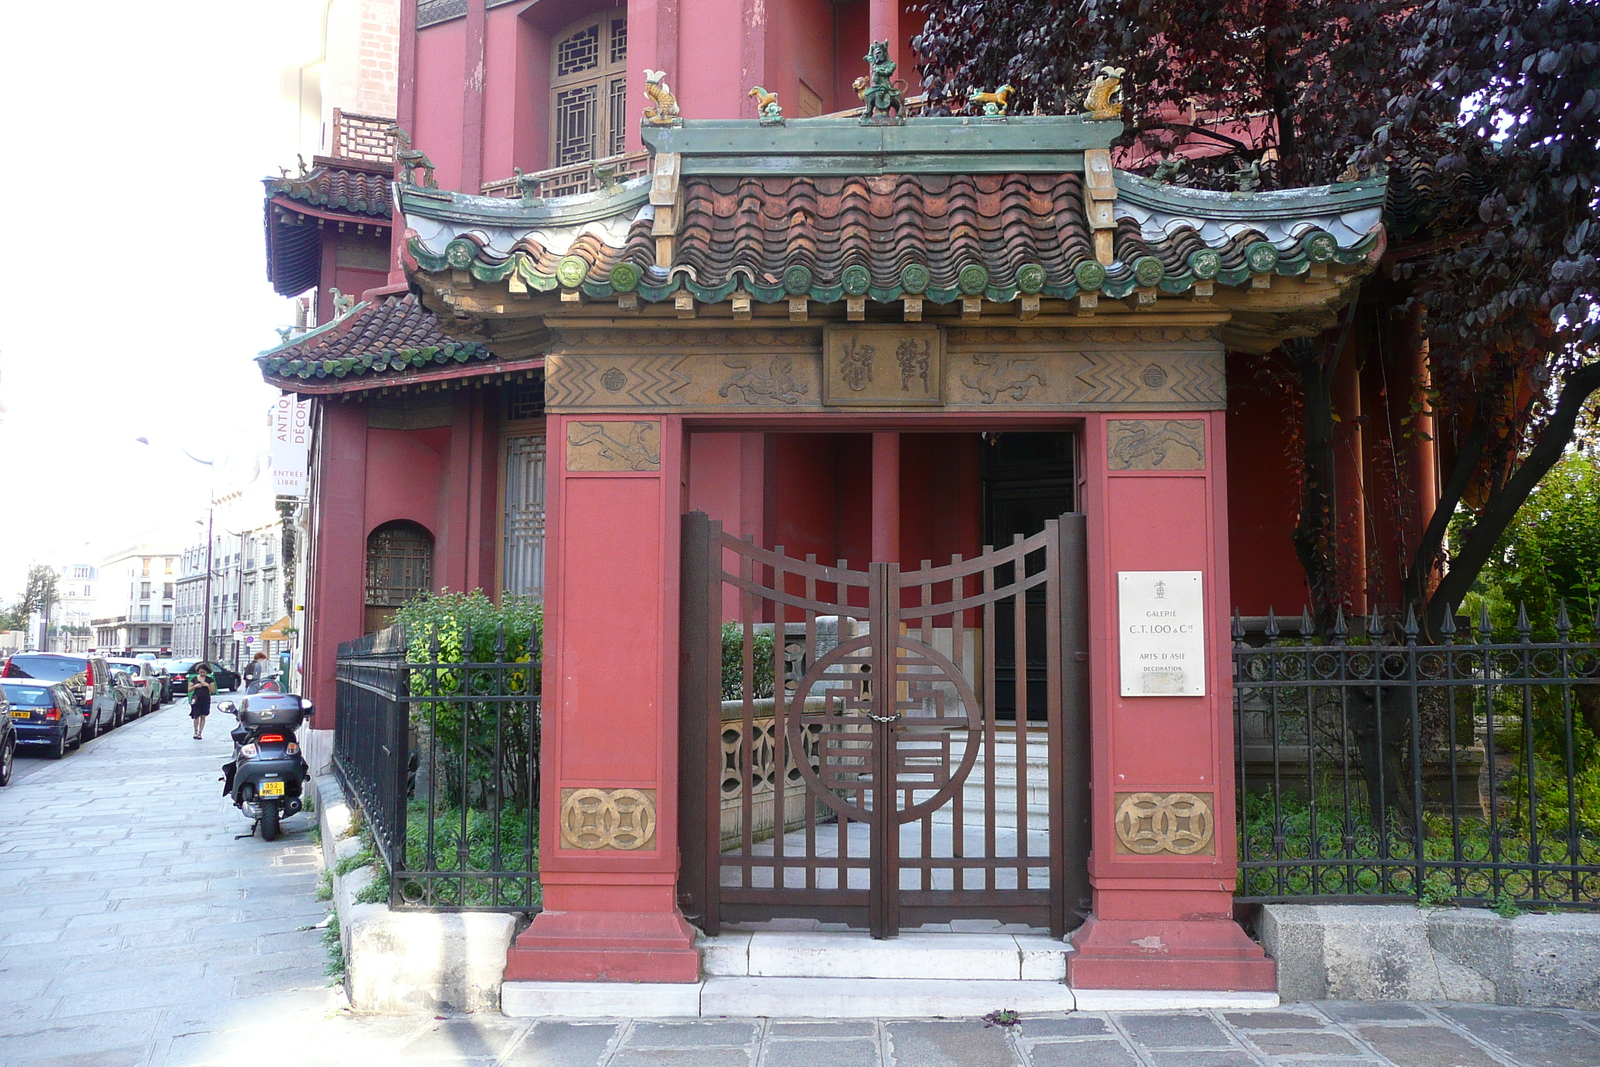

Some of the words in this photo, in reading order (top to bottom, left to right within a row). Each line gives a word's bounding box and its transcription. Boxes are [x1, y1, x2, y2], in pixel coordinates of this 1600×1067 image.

[273, 469, 304, 478] ENTRÉE
[277, 479, 299, 487] LIBRE
[1145, 610, 1178, 618] GALERIE
[1150, 624, 1172, 634] LOO
